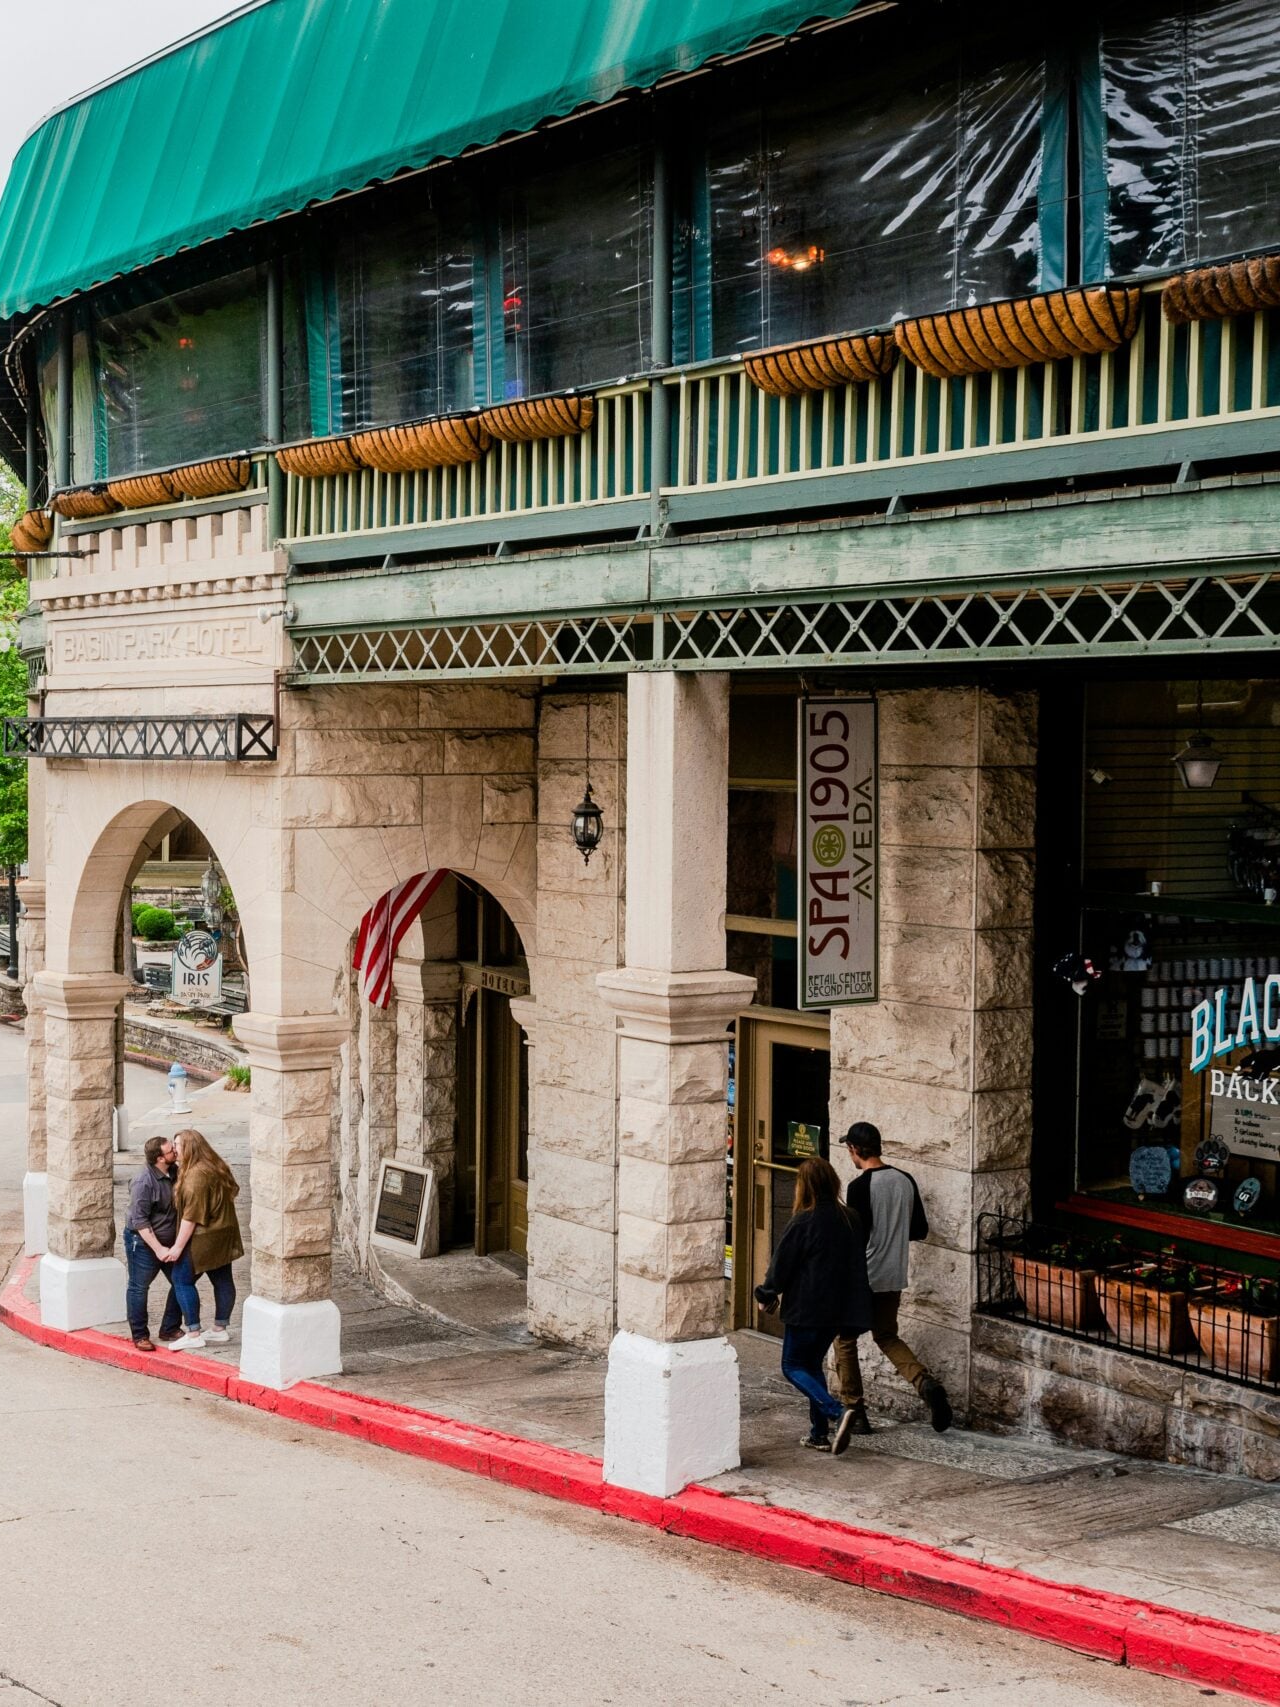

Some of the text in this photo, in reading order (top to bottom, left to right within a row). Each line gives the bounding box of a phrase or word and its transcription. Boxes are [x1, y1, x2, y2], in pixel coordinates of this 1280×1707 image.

[64, 621, 265, 662] BASIN PARK HOTEL
[808, 710, 850, 960] SPA 1905
[853, 775, 873, 900] AVEDA
[183, 972, 210, 986] IRIS
[481, 971, 517, 994] HOTEL
[808, 971, 872, 986] RETAIL CENTER
[808, 982, 873, 998] SECOND FLOOR
[1210, 1069, 1280, 1105] BACK
